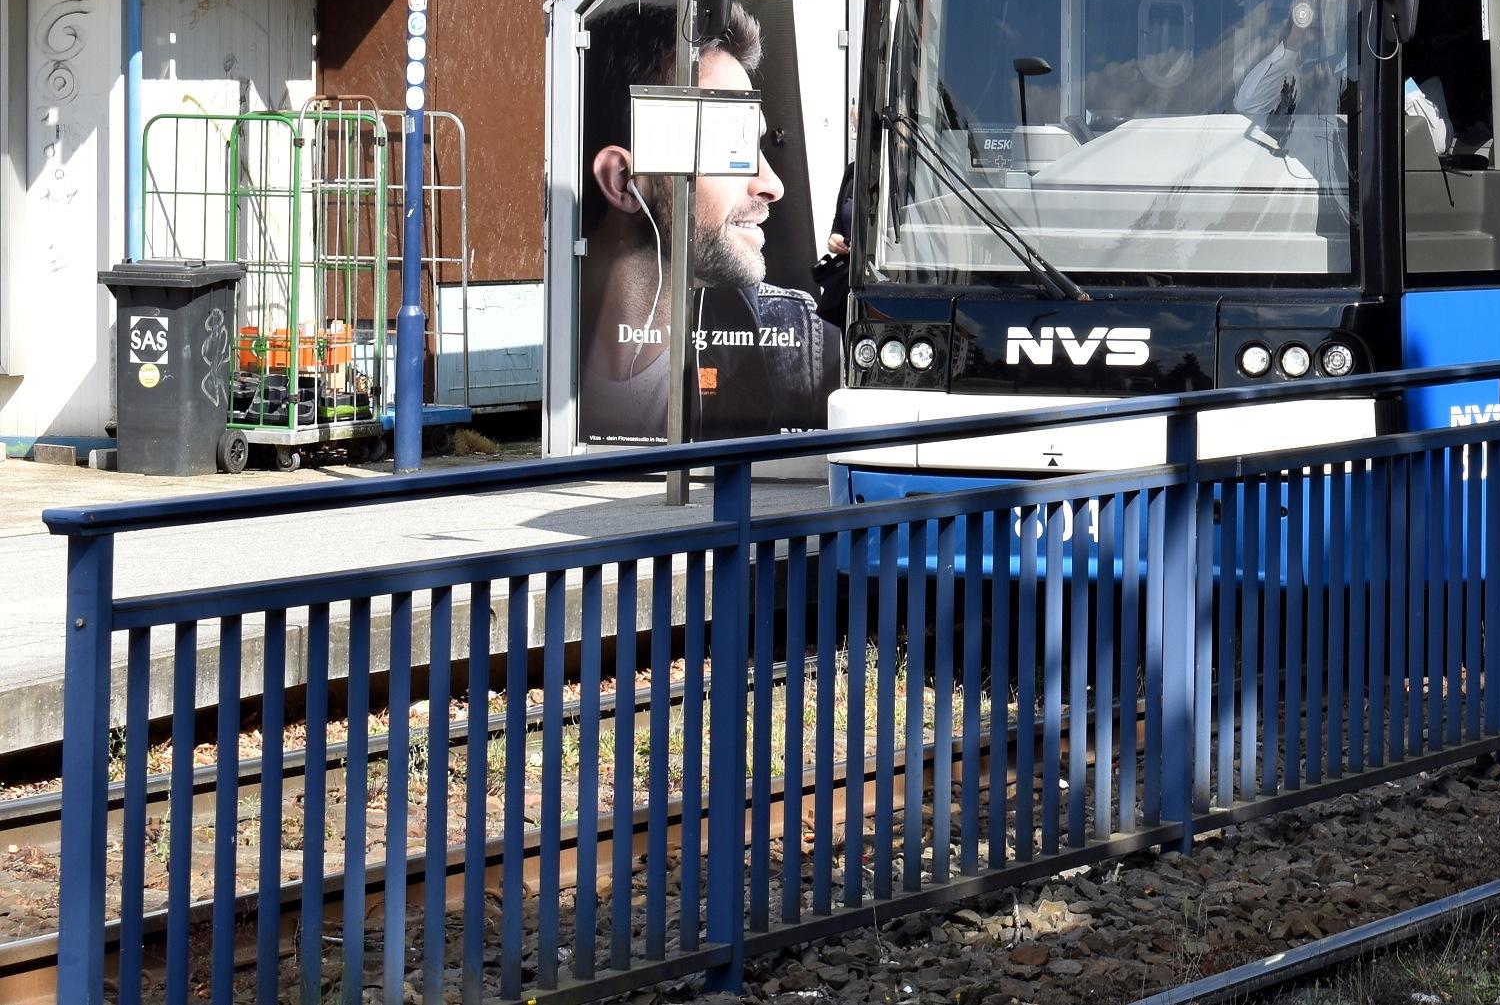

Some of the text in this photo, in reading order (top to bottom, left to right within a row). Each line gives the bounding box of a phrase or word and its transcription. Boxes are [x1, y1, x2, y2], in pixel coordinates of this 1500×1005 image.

[130, 329, 168, 352] SAS
[618, 324, 662, 344] Dein
[712, 331, 754, 346] zum
[759, 327, 800, 347] Ziel.
[1006, 326, 1151, 366] NVS
